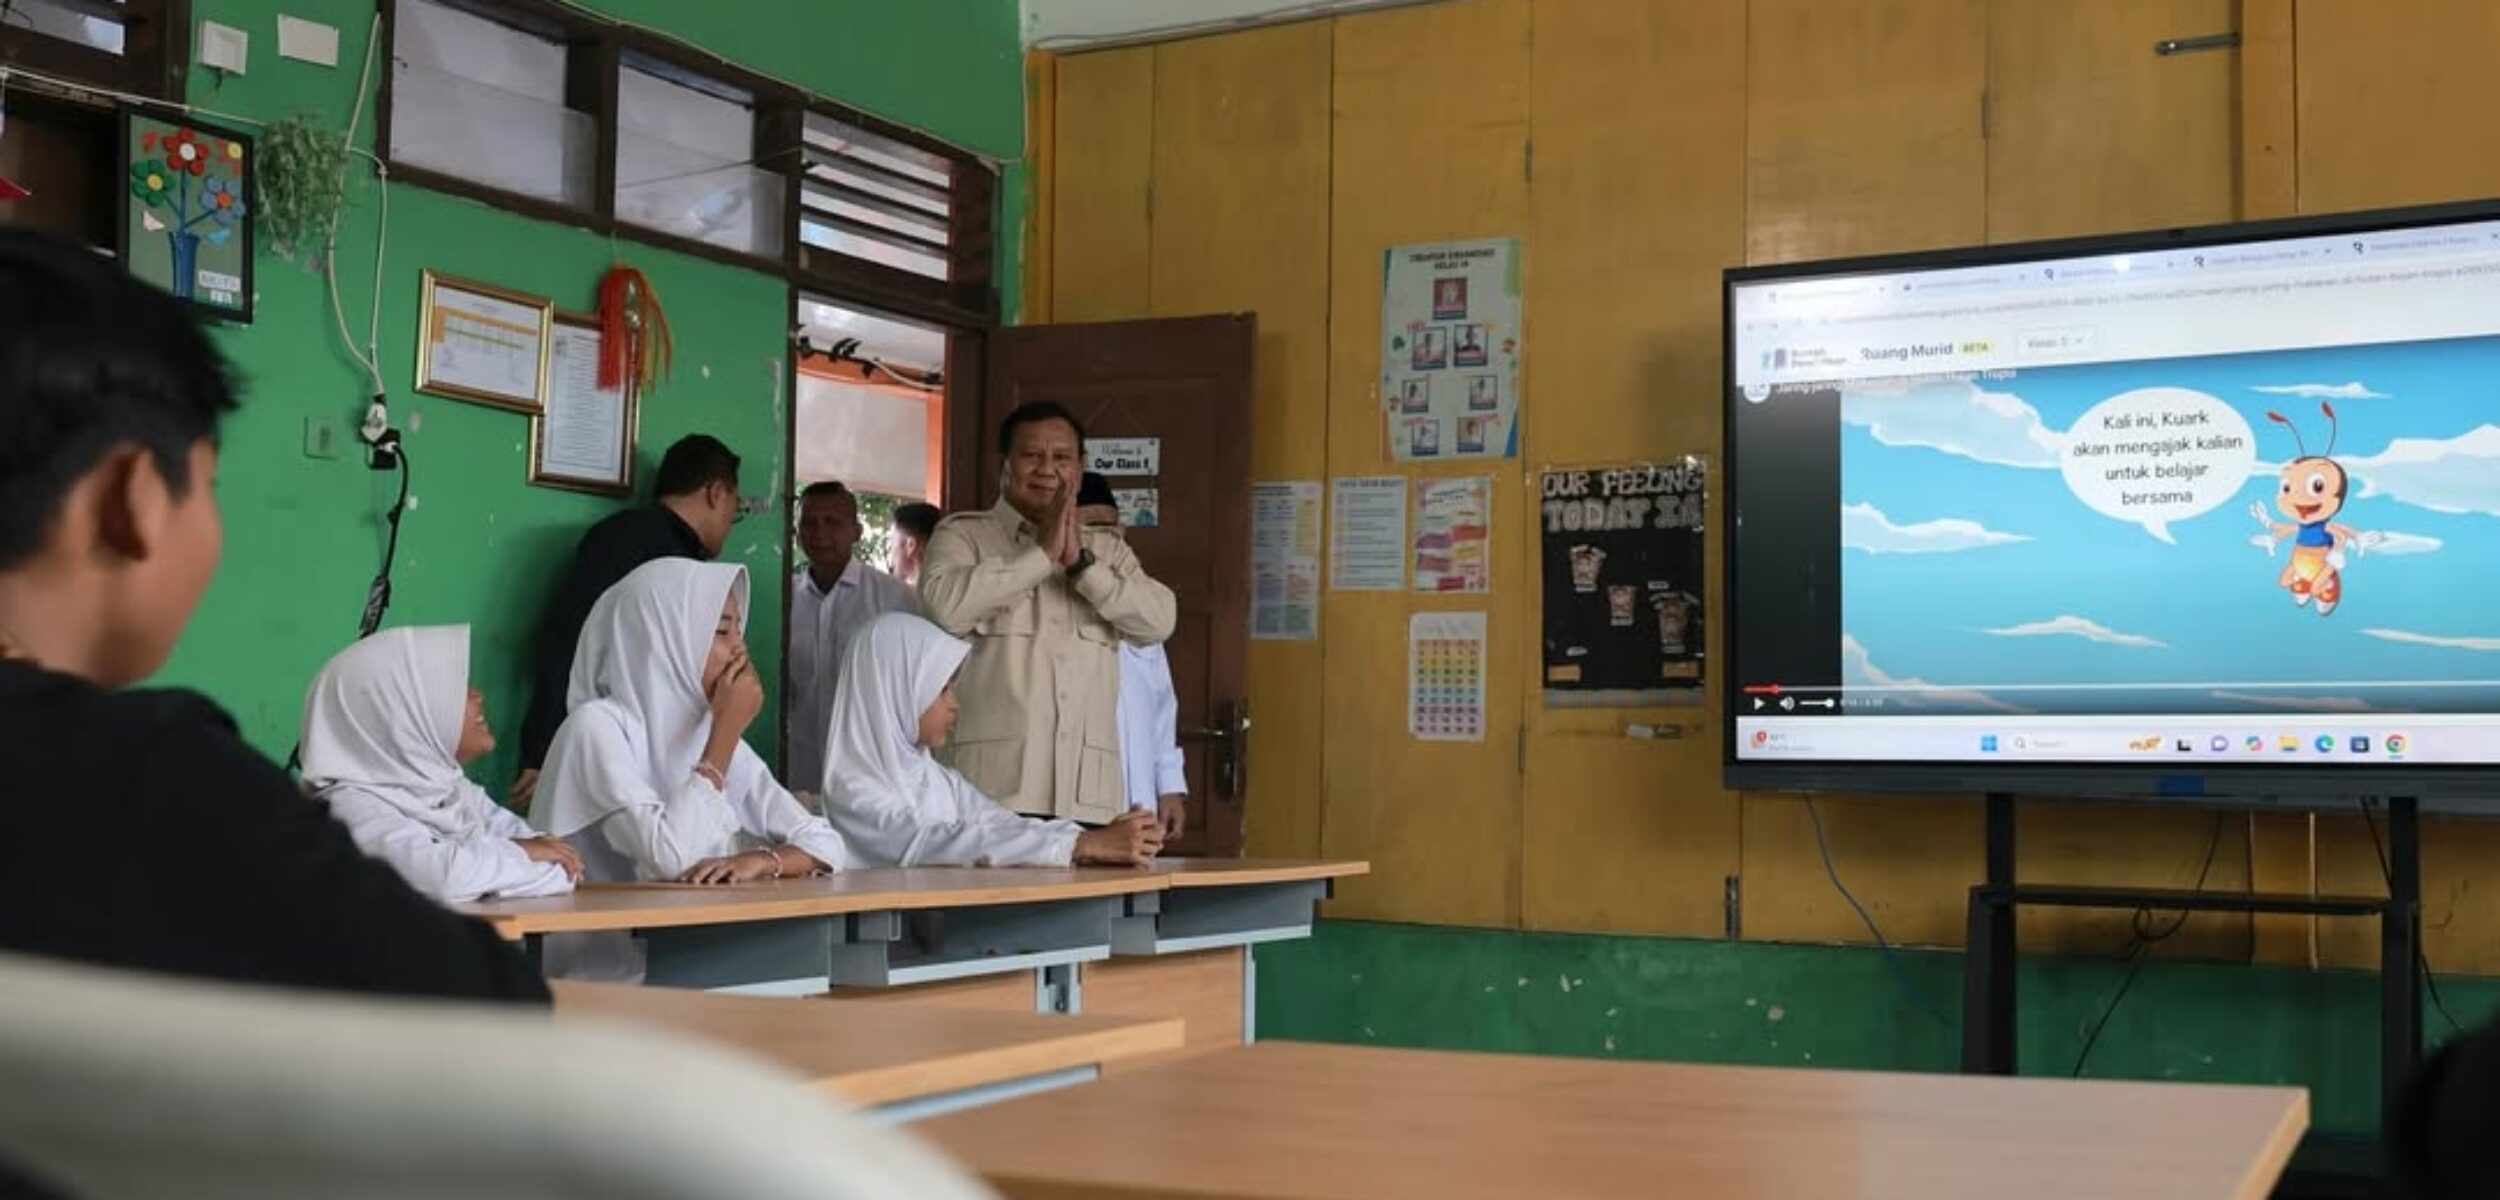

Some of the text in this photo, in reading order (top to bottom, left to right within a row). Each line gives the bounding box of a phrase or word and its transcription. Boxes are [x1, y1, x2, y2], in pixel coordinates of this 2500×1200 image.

[1911, 342, 1954, 358] Murid
[2103, 410, 2210, 429] Kali ini, Kuark
[2073, 435, 2243, 457] akan mengajak kalian
[1095, 457, 1114, 469] Our
[1116, 457, 1142, 469] Class
[2105, 462, 2209, 481] untuk belajar
[1543, 464, 1703, 498] OUR FEELING
[2122, 491, 2193, 506] bersama
[1544, 496, 1651, 533] TODAY
